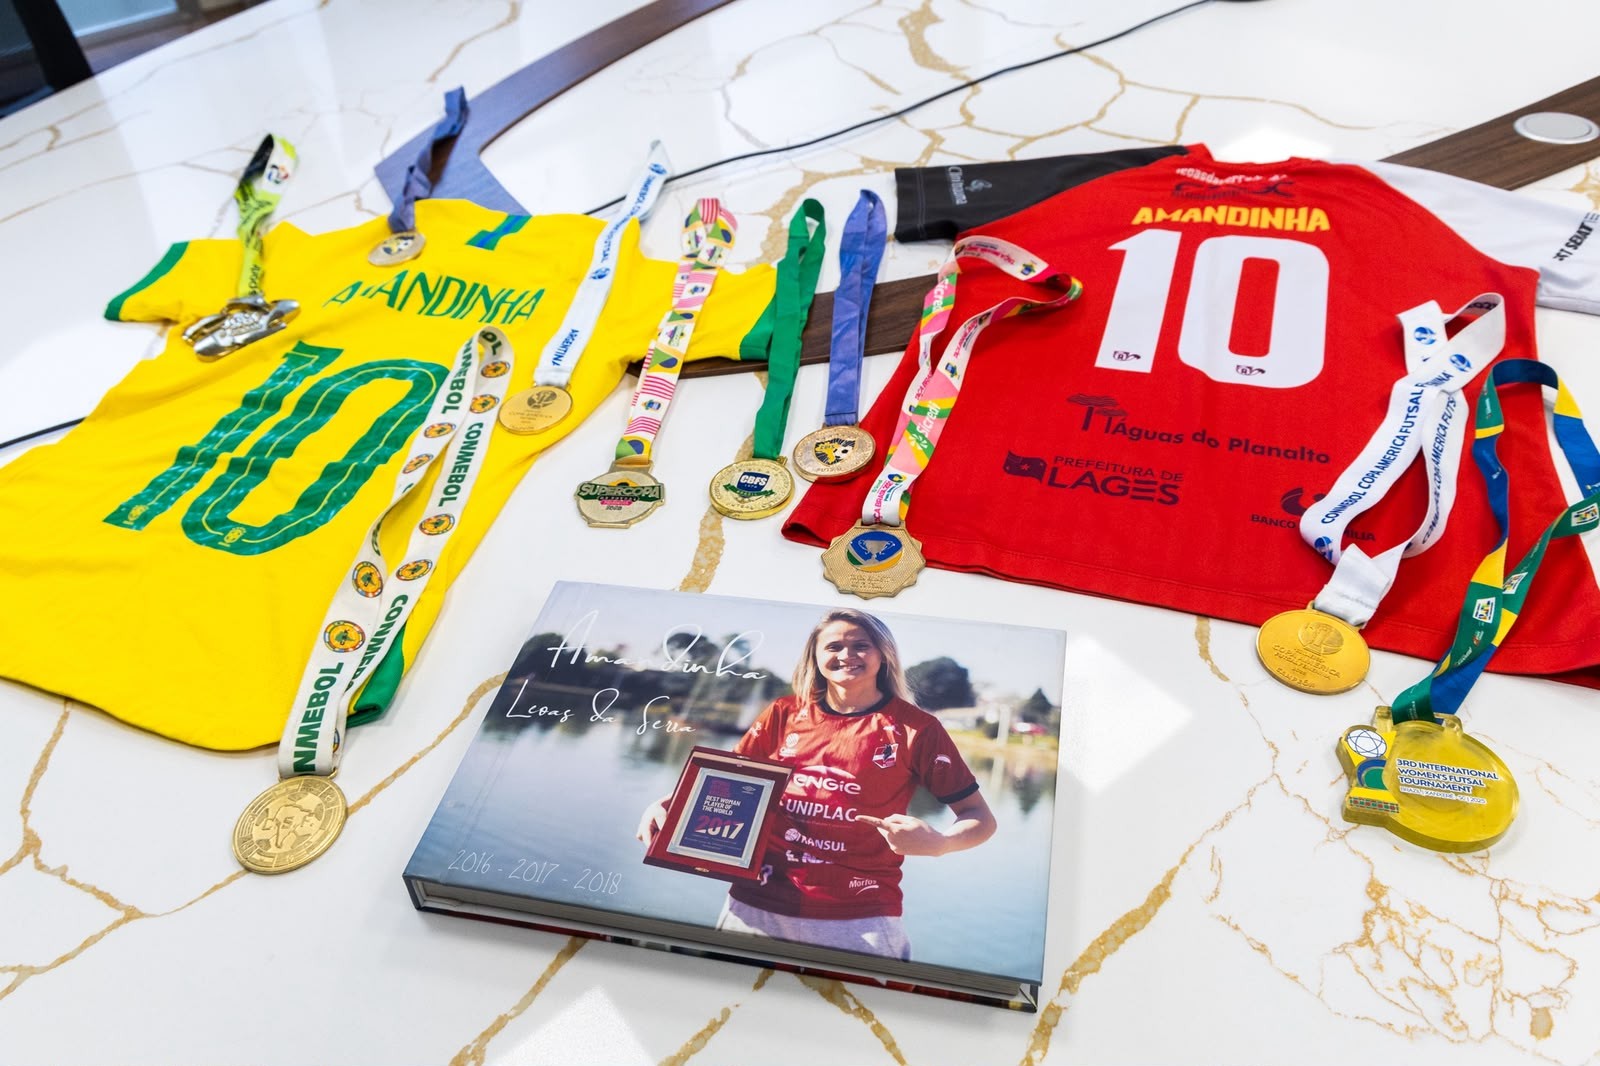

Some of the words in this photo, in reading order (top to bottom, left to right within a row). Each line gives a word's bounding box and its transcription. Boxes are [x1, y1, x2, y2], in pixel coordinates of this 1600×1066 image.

[1131, 205, 1331, 232] AMANDINHA
[322, 269, 545, 325] AANDINHA
[1094, 228, 1330, 389] 10
[552, 328, 580, 367] ARGENTINA
[441, 336, 474, 414] NMEBOL
[916, 400, 942, 437] Sicredi
[1431, 425, 1448, 468] AMERICA
[1440, 397, 1457, 425] FUTS
[102, 340, 450, 557] 10
[1112, 421, 1184, 444] Águas
[1191, 428, 1220, 448] do
[1228, 438, 1330, 465] Planalto
[1321, 489, 1367, 524] CONMEBOL
[1358, 469, 1381, 497] COPA
[1376, 432, 1405, 472] AMERICA
[1399, 388, 1424, 434] FUTSAL
[438, 422, 484, 508] CONMEBOL
[740, 475, 767, 486] CBFS
[1054, 456, 1155, 479] PREFEITURA
[1160, 470, 1184, 483] DE
[580, 483, 660, 499] SUPERCOPA
[1047, 467, 1180, 506] LAGES
[1251, 514, 1296, 529] BANCO
[547, 609, 768, 682] Amandinha
[293, 662, 344, 773] NMEBOL
[506, 679, 575, 723] Leoas
[590, 687, 620, 724] da
[636, 695, 697, 735] Serra
[1397, 759, 1417, 768] 3RD
[1418, 762, 1498, 780] INTERNATIONAL
[1398, 768, 1448, 781] WOMEN'S
[1449, 775, 1484, 787] FUTSAL
[1399, 776, 1472, 793] TOURNAMENT
[703, 800, 723, 809] PLAYER
[713, 808, 733, 816] WORLD
[720, 797, 742, 806] WOMAN
[786, 799, 858, 822] UNIPLAC
[694, 815, 745, 840] 2017
[795, 833, 847, 852] TRANSUL
[448, 850, 494, 875] 2016
[508, 858, 559, 884] 2017
[573, 868, 623, 894] 2018
